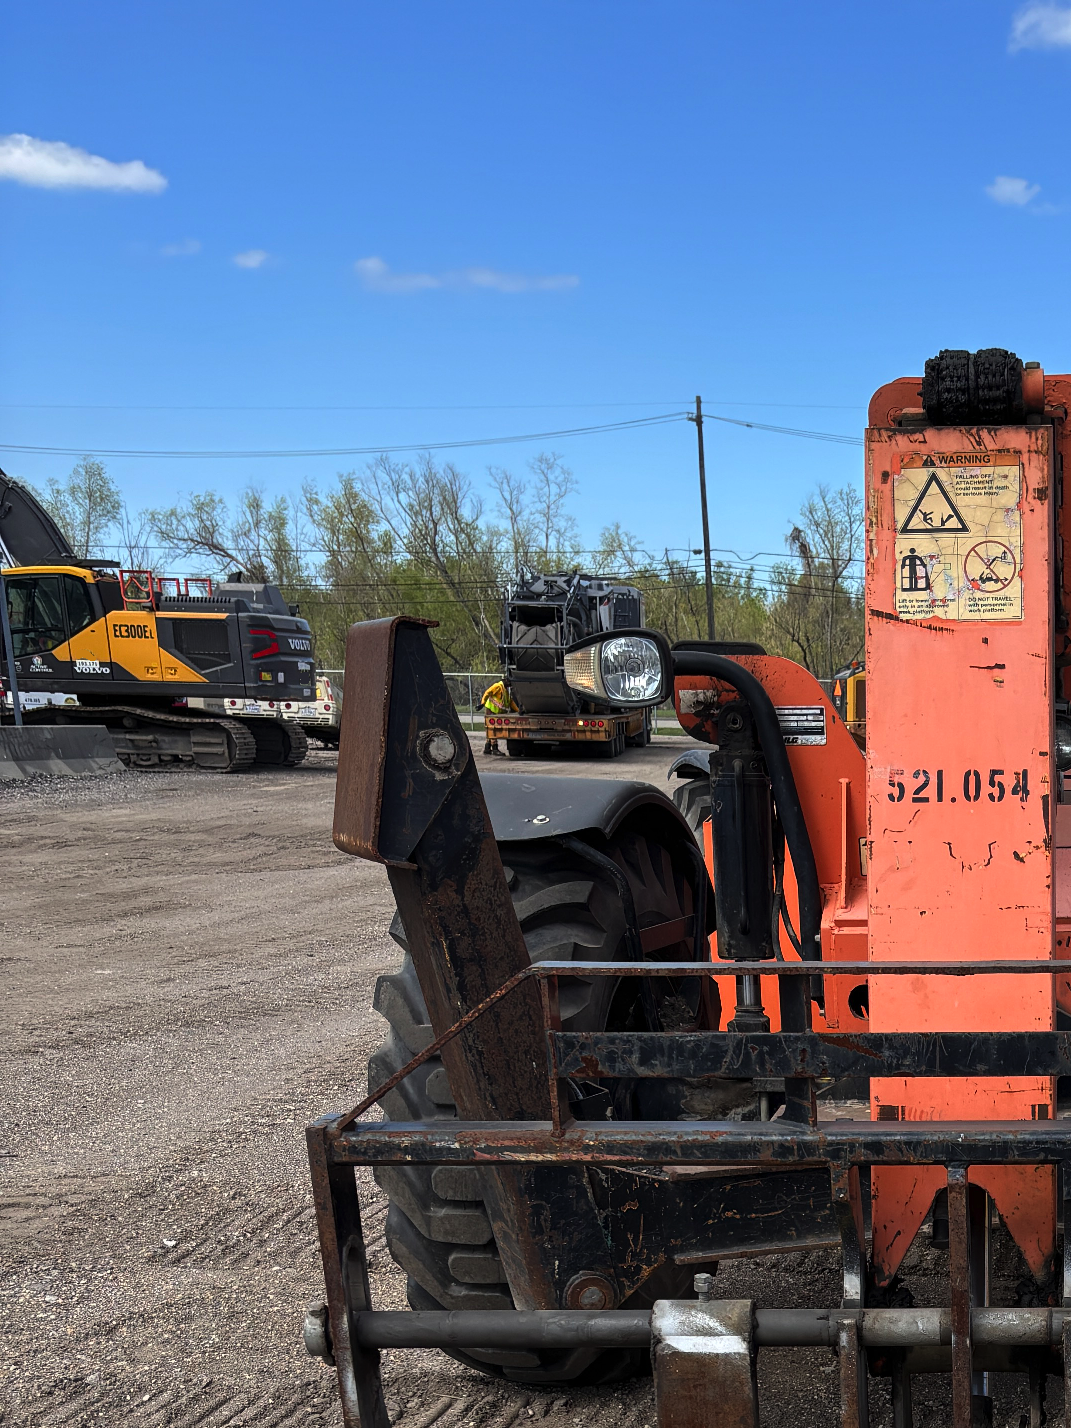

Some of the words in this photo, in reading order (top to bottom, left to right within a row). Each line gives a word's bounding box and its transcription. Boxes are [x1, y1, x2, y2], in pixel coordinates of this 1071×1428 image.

[938, 455, 991, 465] WARNING
[73, 666, 110, 674] VOLVO
[887, 768, 1030, 803] 521.054
